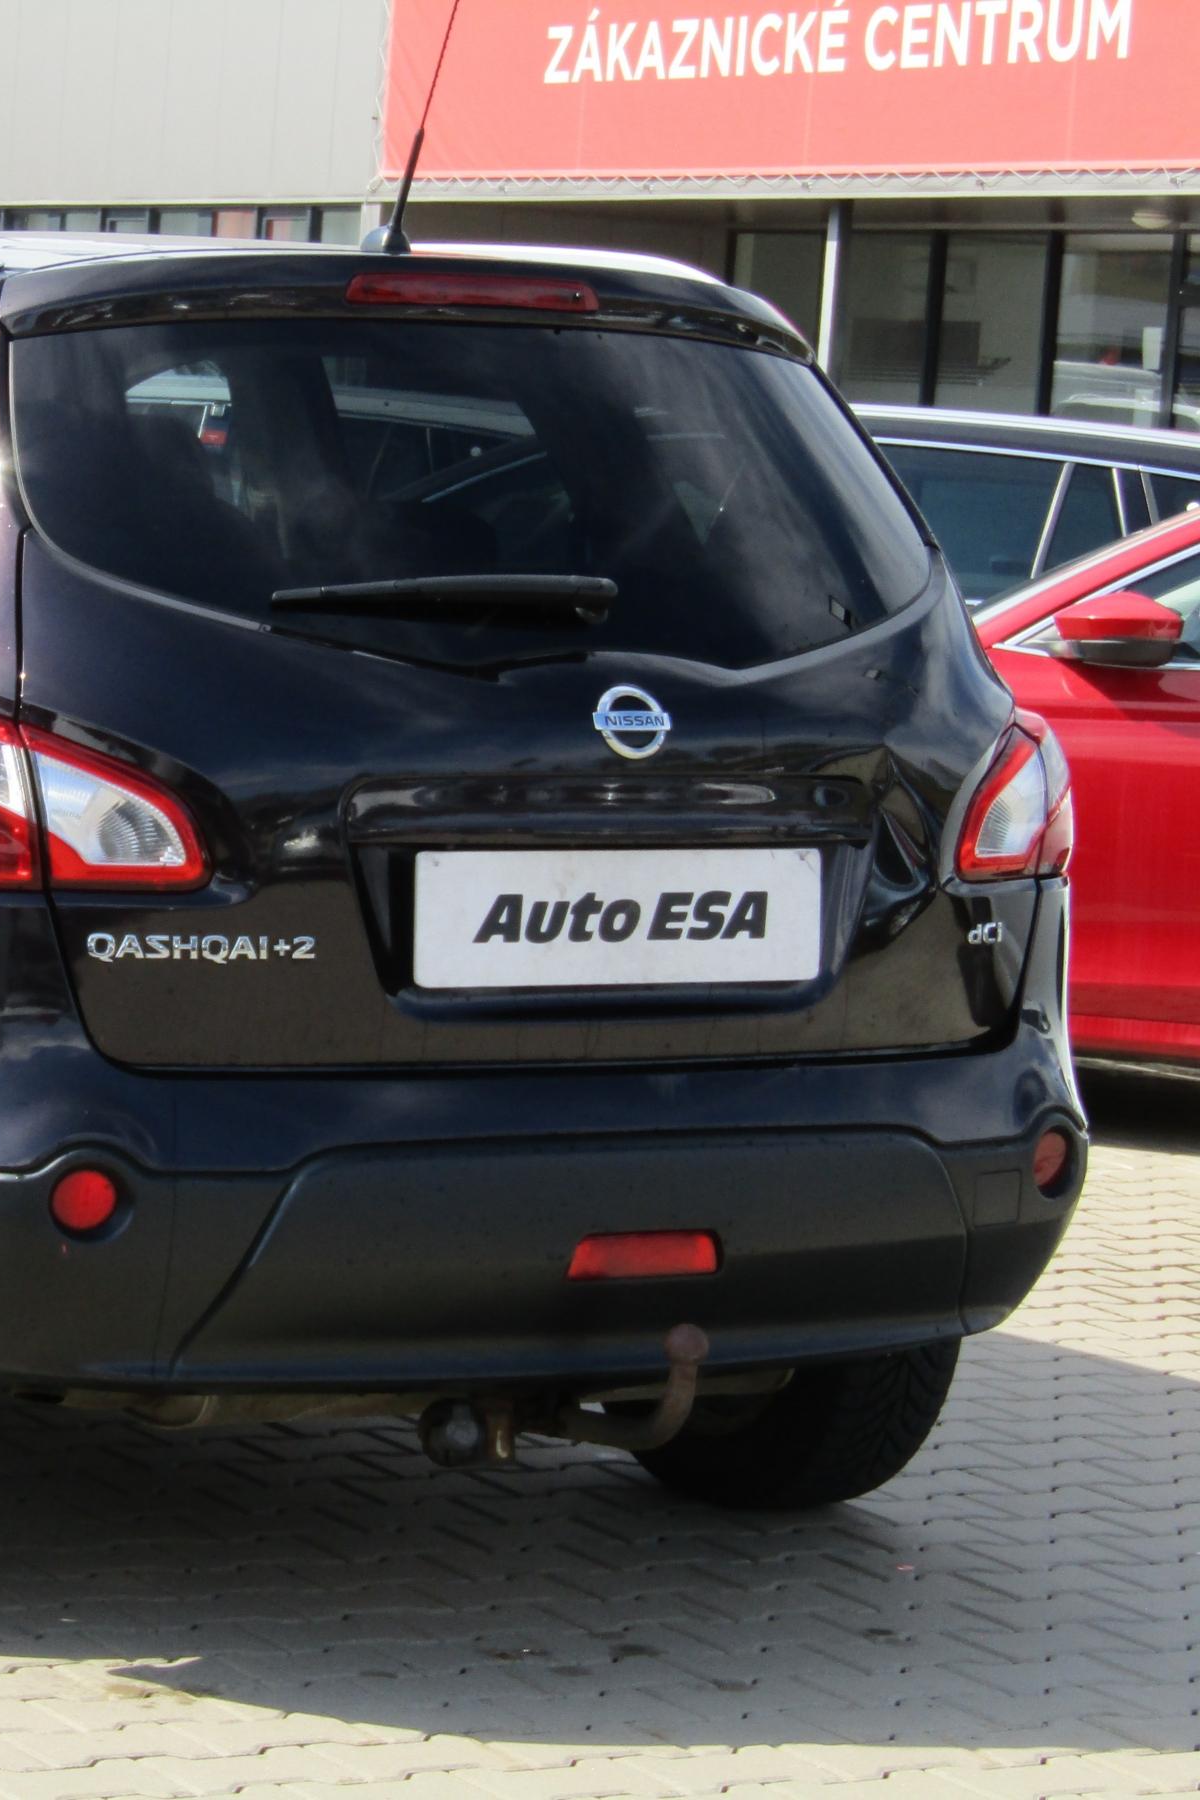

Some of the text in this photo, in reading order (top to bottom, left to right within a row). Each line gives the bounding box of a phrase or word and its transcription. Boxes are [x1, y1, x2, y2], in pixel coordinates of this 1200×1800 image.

[543, 0, 1131, 84] ZÁKAZNICKÉ CENTRUM
[604, 715, 665, 726] NISSAN
[472, 890, 768, 943] Auto ESA
[968, 921, 1002, 944] dCi
[86, 932, 316, 964] QASHQAI+2
